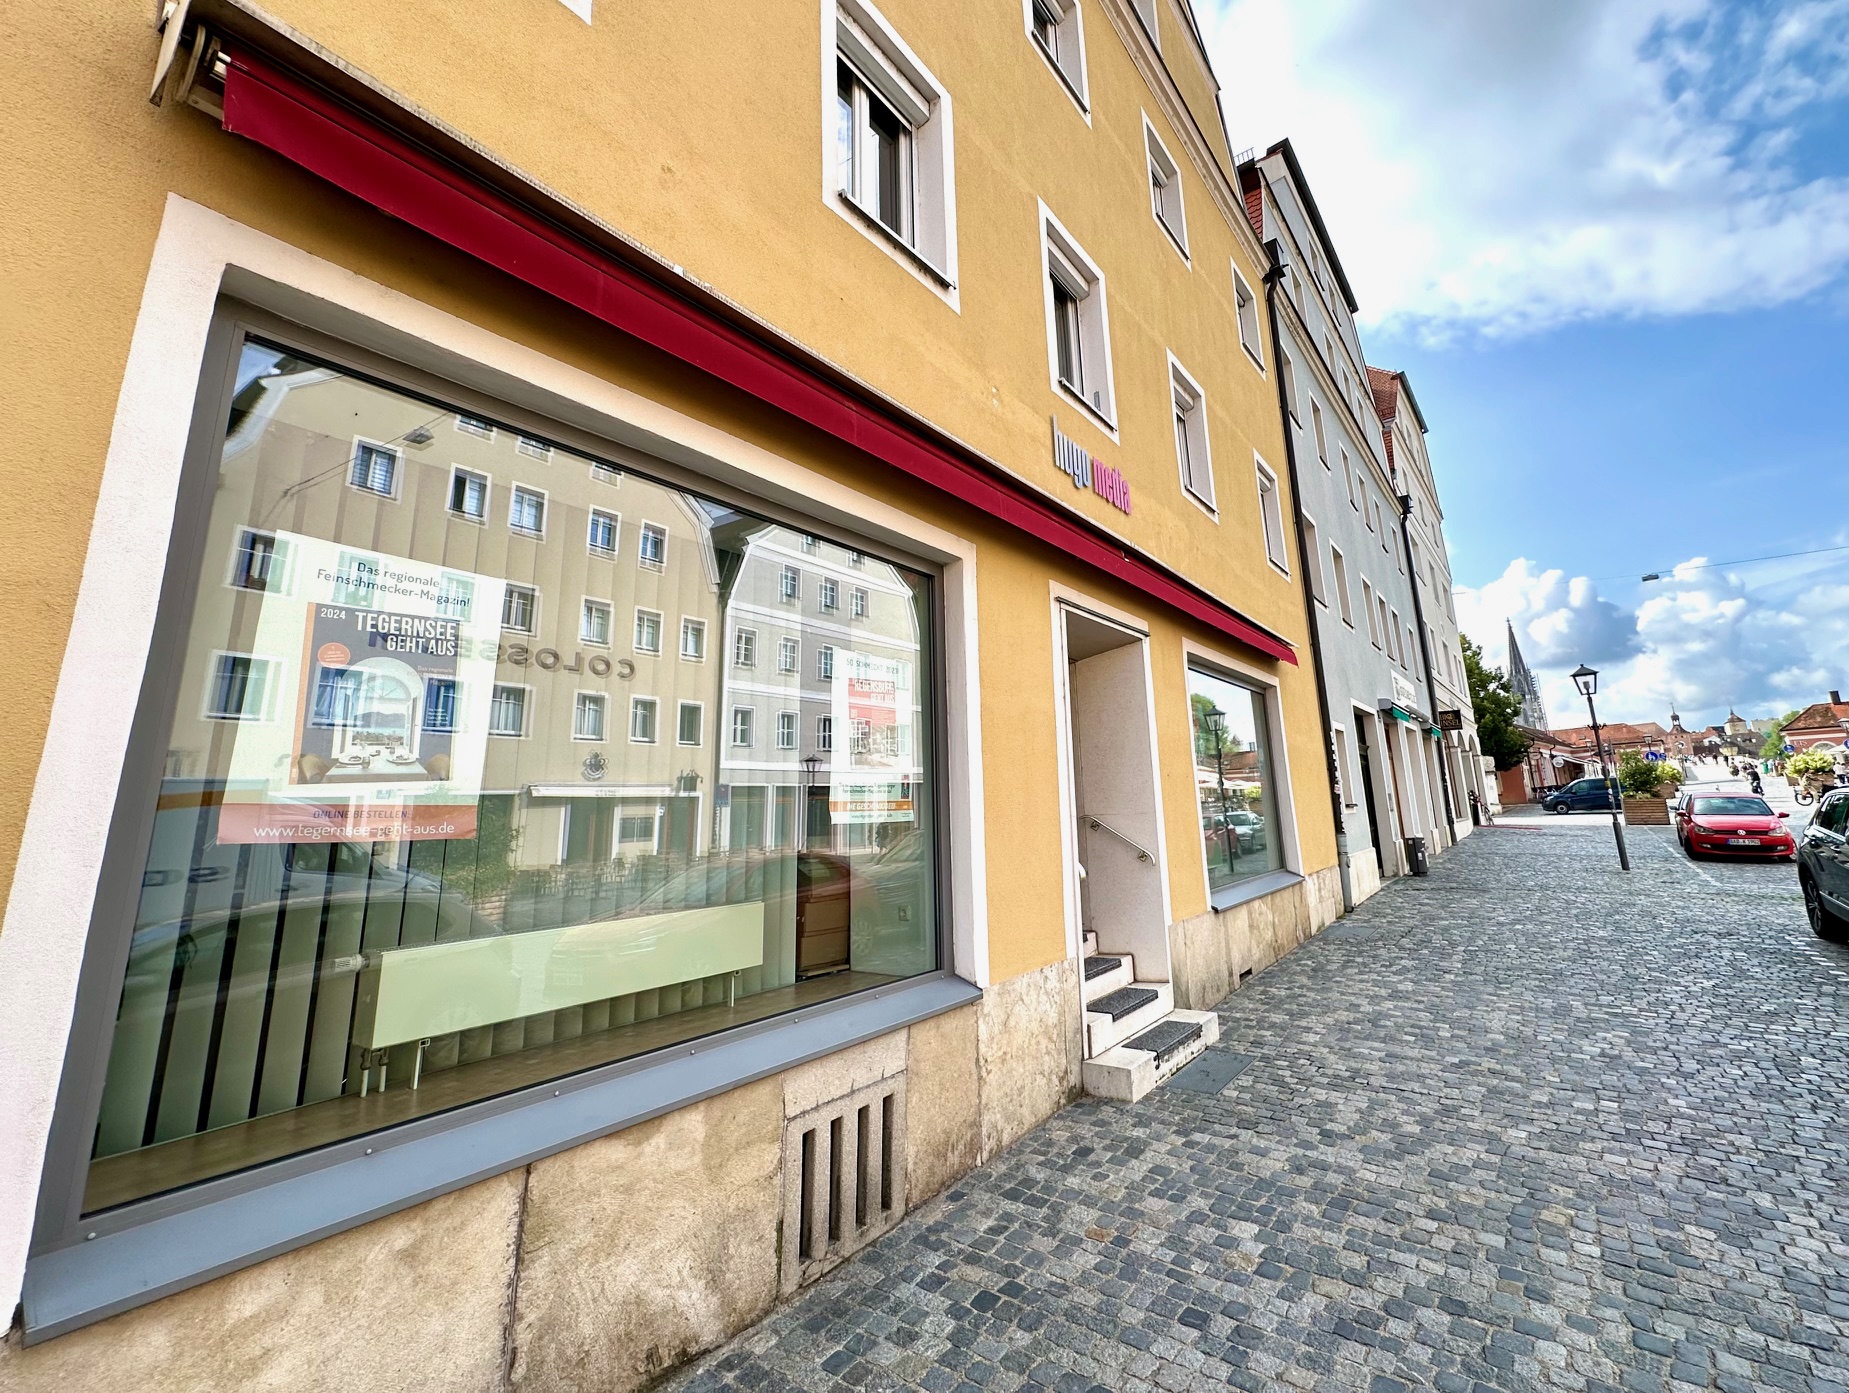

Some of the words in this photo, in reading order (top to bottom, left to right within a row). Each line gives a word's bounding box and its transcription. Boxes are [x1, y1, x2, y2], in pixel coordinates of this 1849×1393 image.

[1052, 412, 1091, 489] hugo
[1092, 456, 1132, 516] media
[357, 562, 380, 576] Das
[384, 569, 440, 588] regionale
[317, 568, 470, 607] Feinschmecker-Magazin!
[320, 608, 347, 620] 2024
[355, 611, 457, 641] TEGERNSEE
[387, 635, 426, 655] GEHT
[427, 640, 456, 656] AUS
[854, 679, 895, 693] REGENSBURG
[313, 810, 350, 819] ONLINE
[353, 810, 410, 819] BESTELLEN:
[254, 821, 455, 839] www.tegernsee-geht-aus.de
